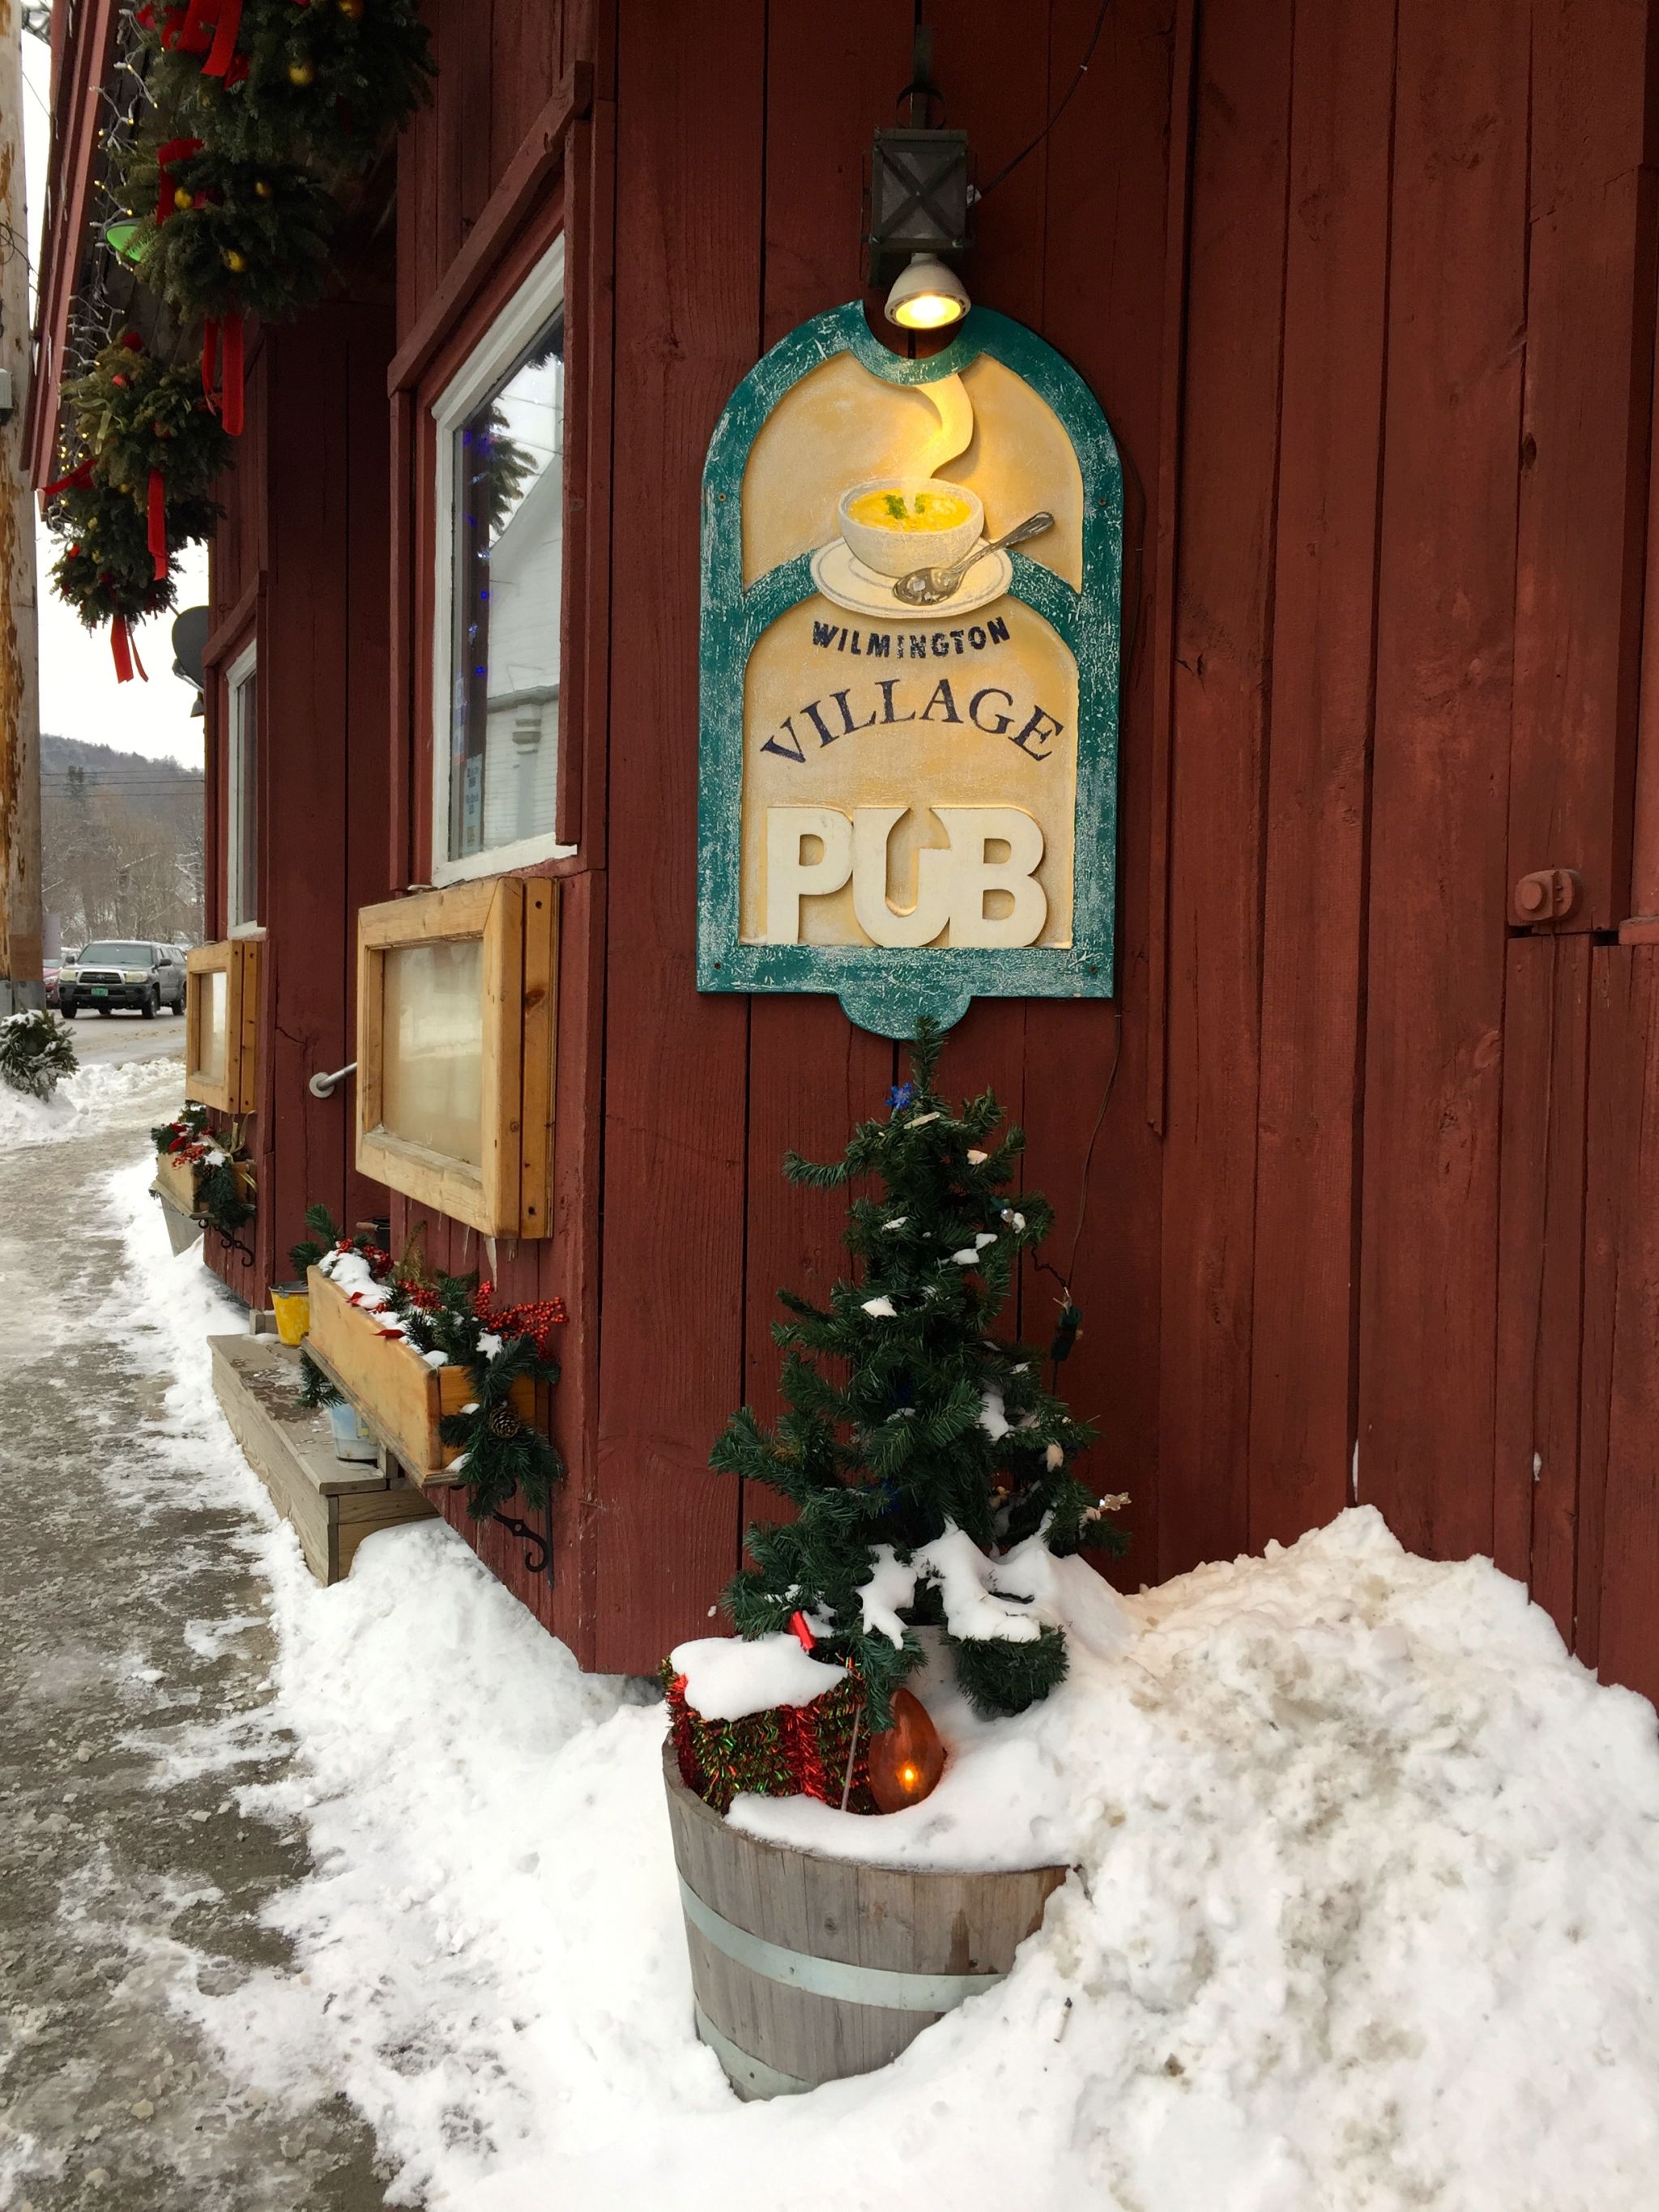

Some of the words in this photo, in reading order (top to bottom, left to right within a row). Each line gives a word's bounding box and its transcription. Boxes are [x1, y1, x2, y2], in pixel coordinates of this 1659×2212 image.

[812, 616, 1011, 658] WILMINGTON
[760, 678, 1064, 764] VILLAGE
[766, 806, 1048, 947] PUB
